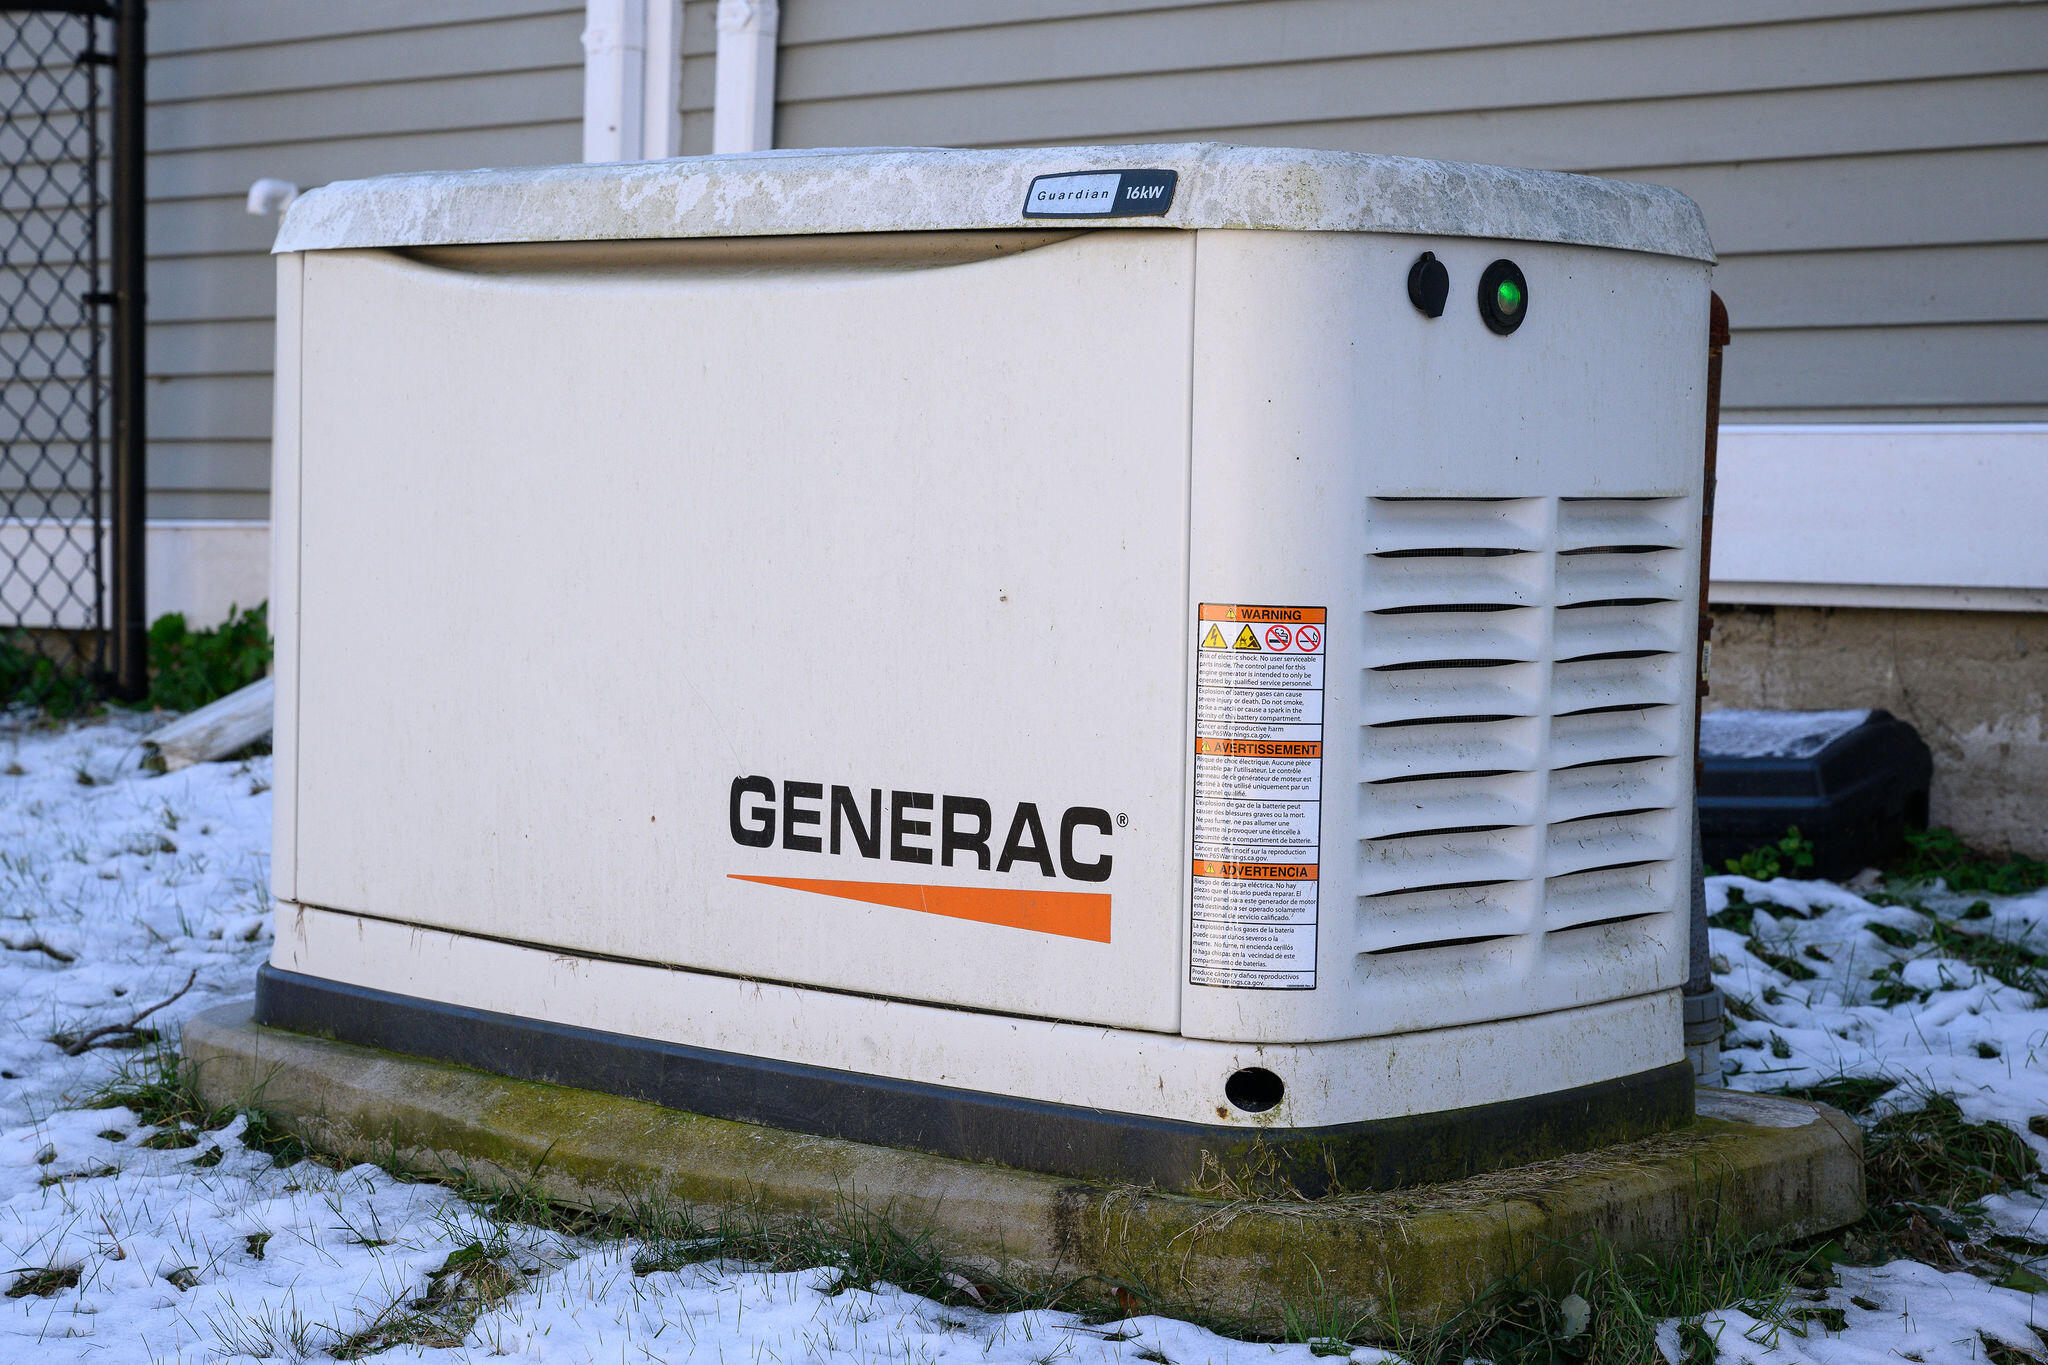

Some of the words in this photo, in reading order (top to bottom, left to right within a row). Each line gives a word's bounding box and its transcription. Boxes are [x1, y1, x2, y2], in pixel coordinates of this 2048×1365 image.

[1037, 190, 1109, 200] Guardian
[1126, 186, 1164, 200] 16kW
[1241, 609, 1301, 620] WARNING
[1214, 742, 1317, 755] AVERTISSEMENT
[1220, 865, 1308, 877] ADVERTENCIA
